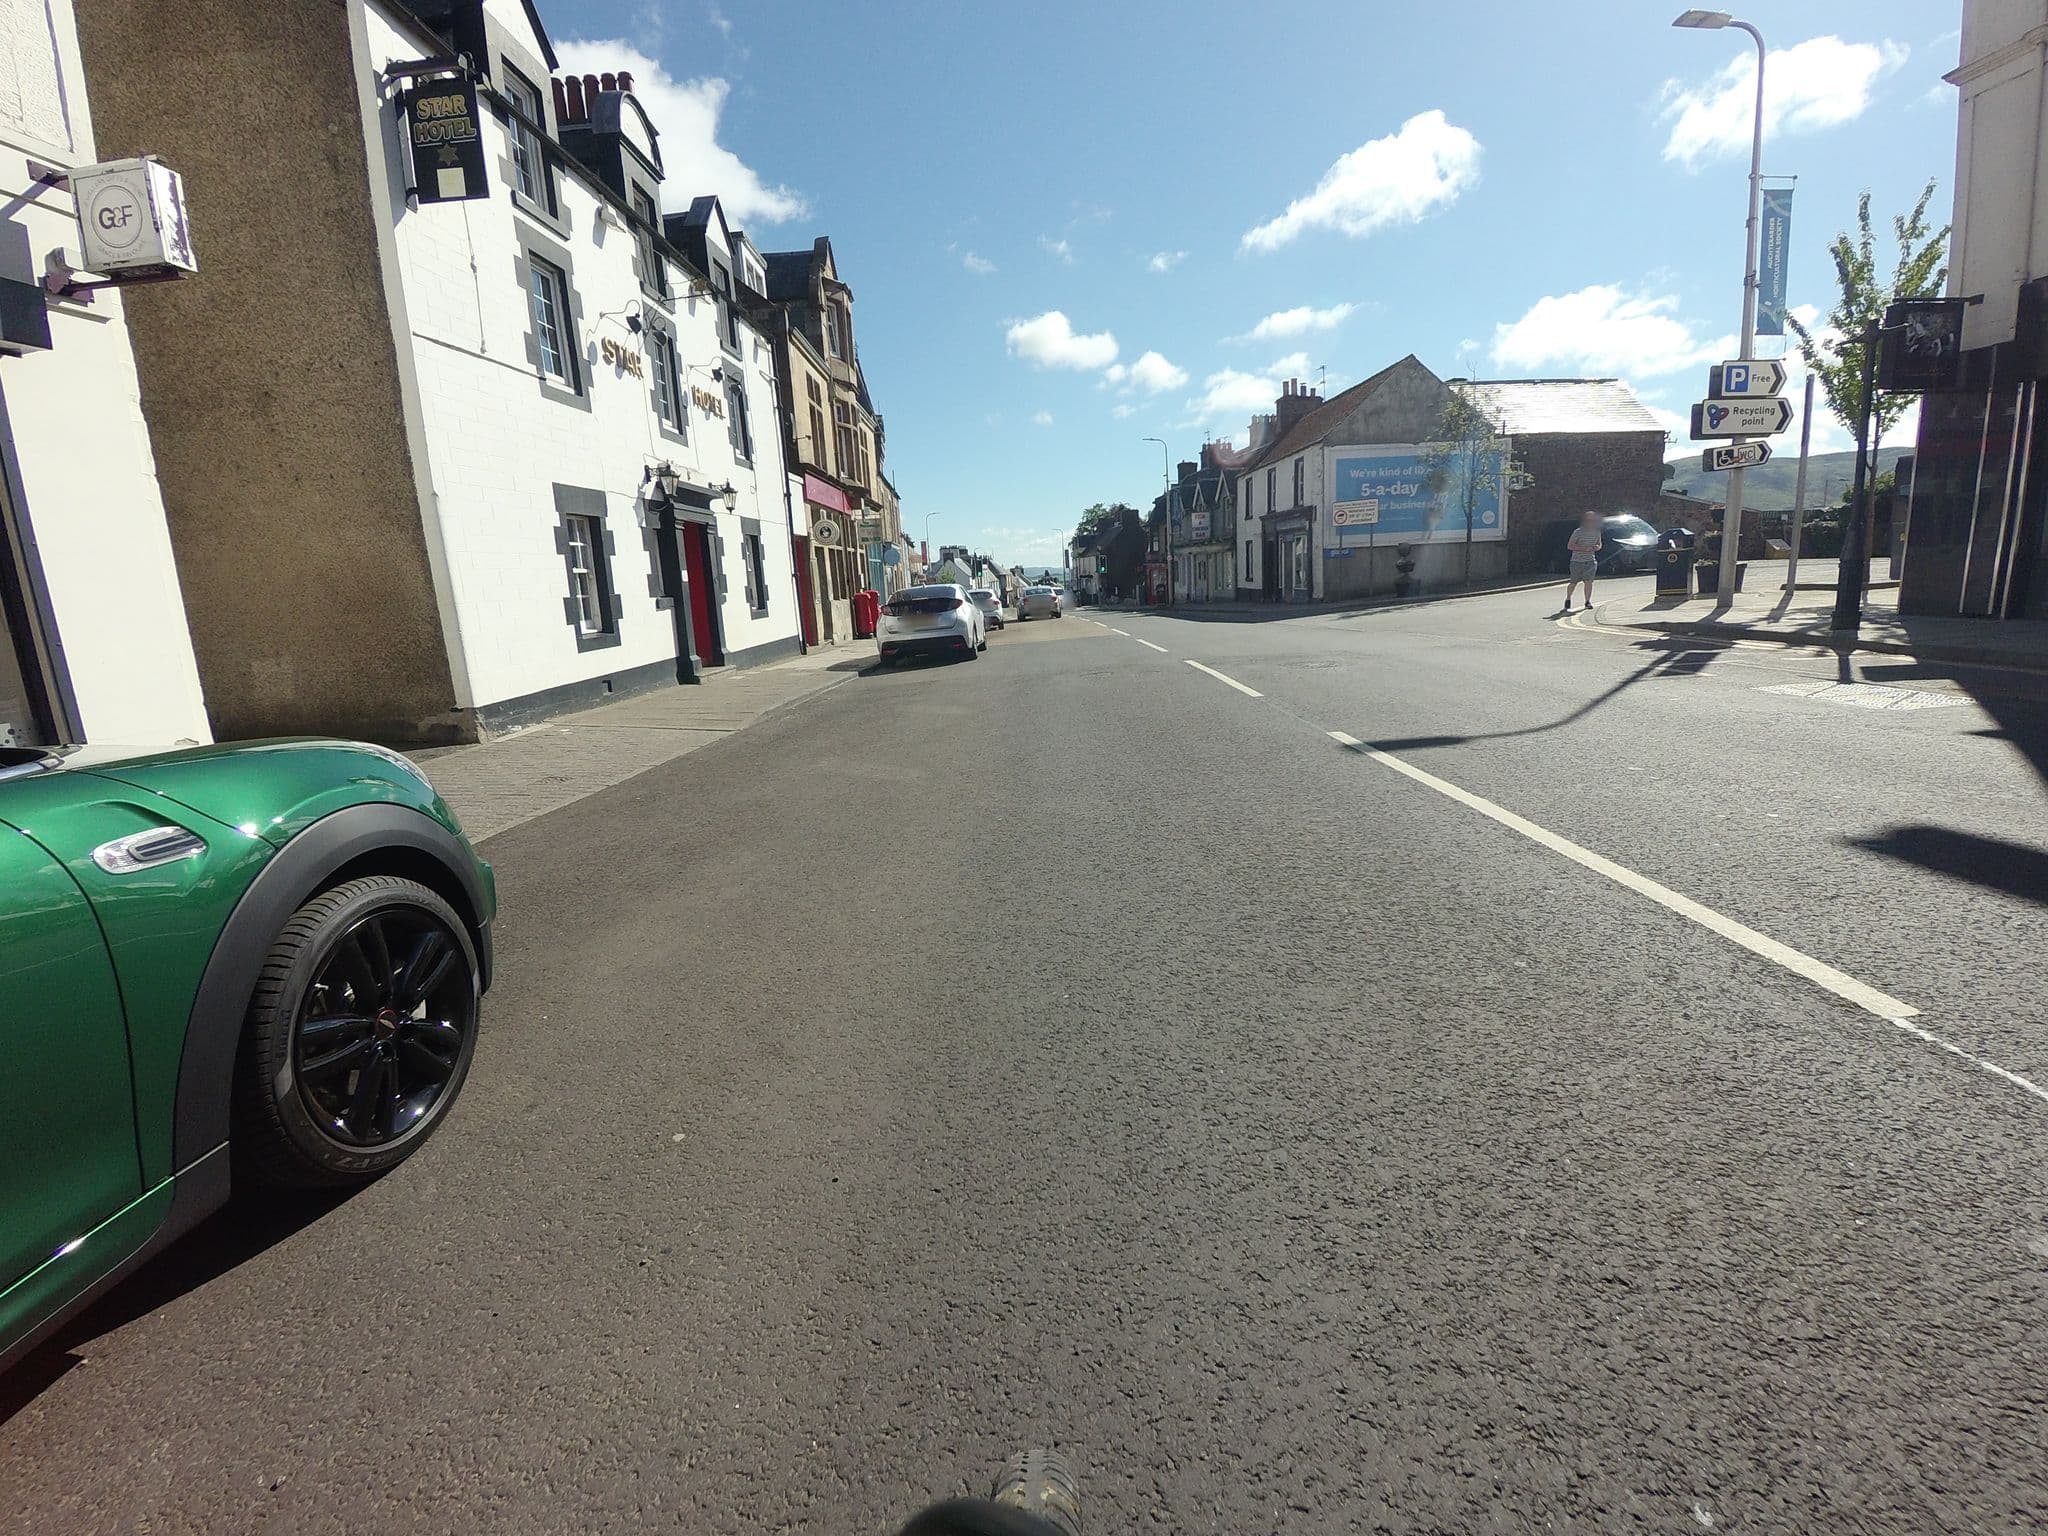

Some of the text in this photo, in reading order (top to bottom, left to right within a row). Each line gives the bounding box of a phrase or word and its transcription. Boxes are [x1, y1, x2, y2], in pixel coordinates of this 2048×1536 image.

[417, 95, 468, 120] STAR
[414, 117, 477, 142] HOTEL
[99, 204, 133, 230] G&F
[1772, 217, 1784, 298] HORTICULTURAL SOCIETY
[600, 336, 644, 381] STAR
[1730, 368, 1771, 390] P Free
[1732, 406, 1776, 416] Recycling
[1741, 417, 1765, 427] point
[1738, 449, 1754, 460] WC
[1350, 468, 1377, 479] We're
[1379, 466, 1401, 477] kind
[1402, 466, 1413, 476] of
[1360, 480, 1420, 497] 5-a-day
